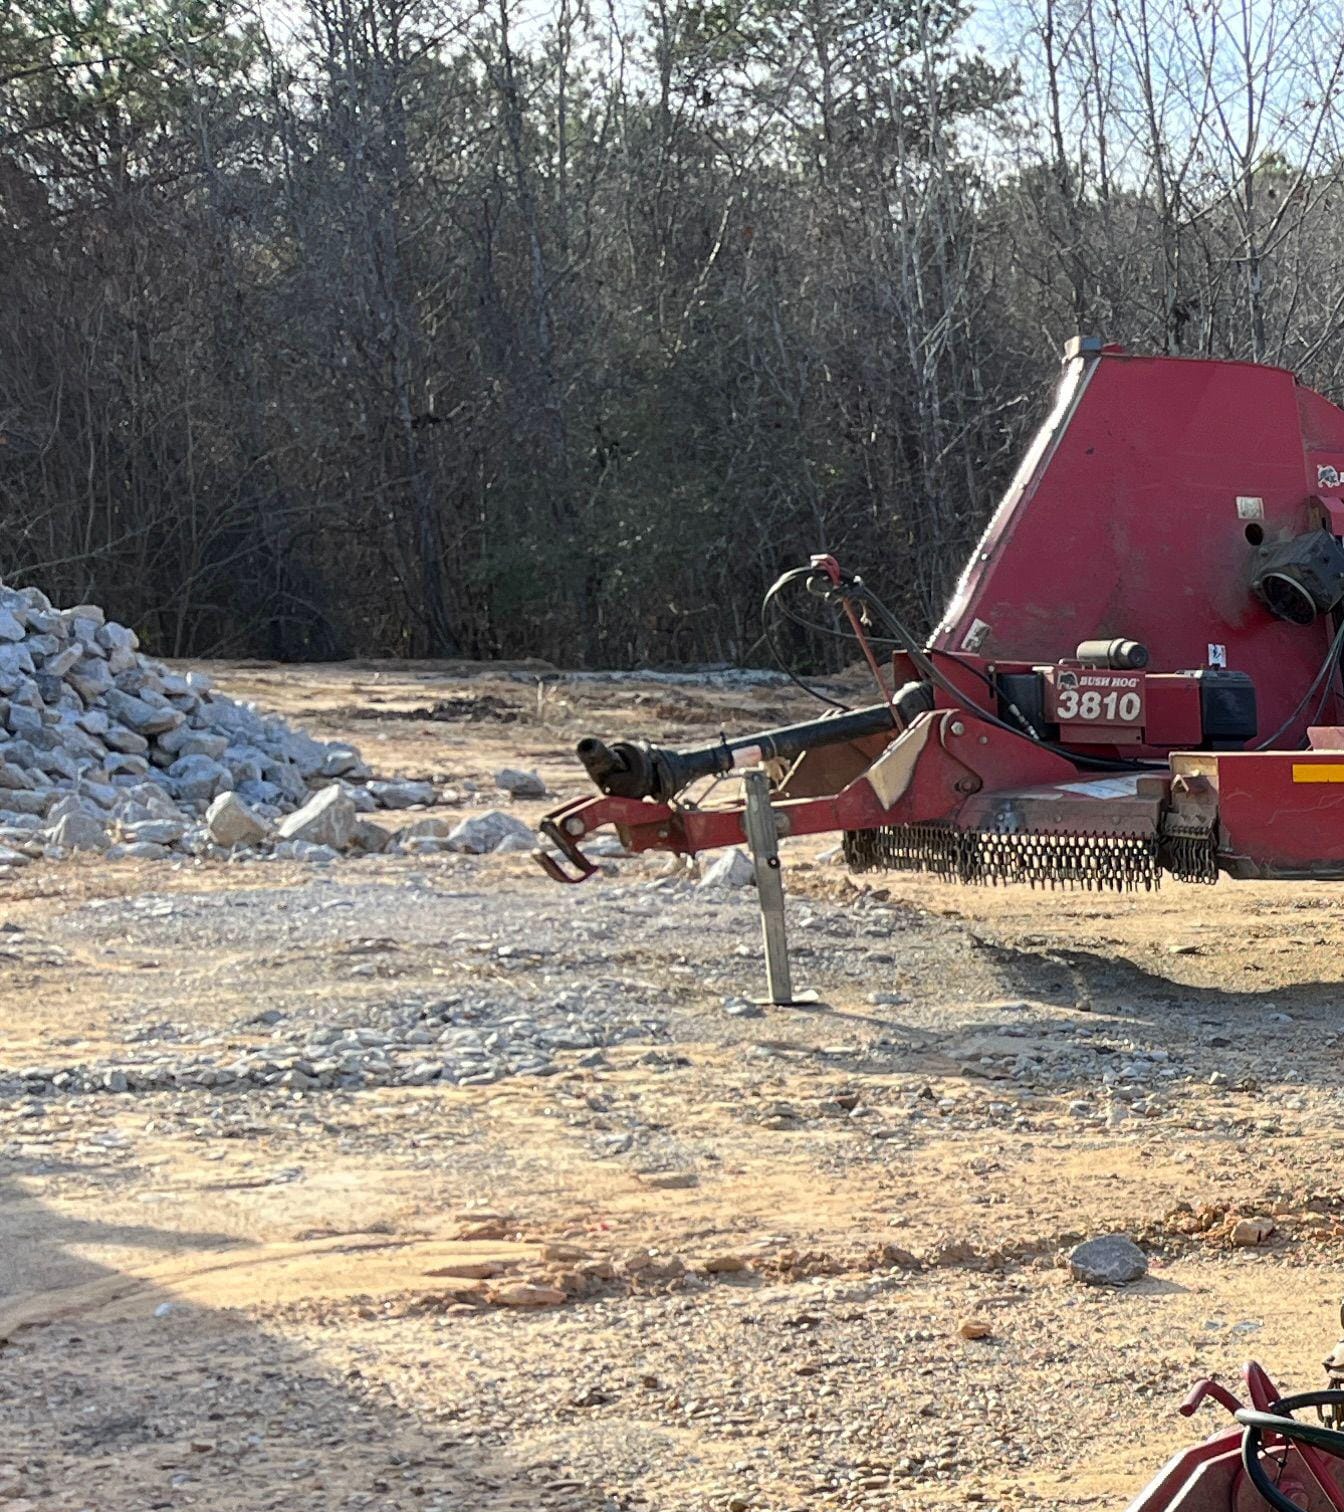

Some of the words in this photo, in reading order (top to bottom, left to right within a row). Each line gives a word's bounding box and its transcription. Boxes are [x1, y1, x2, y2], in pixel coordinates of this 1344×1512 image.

[1079, 676, 1109, 687] BUSH
[1111, 678, 1138, 688] HOG
[1057, 690, 1141, 721] 3810
